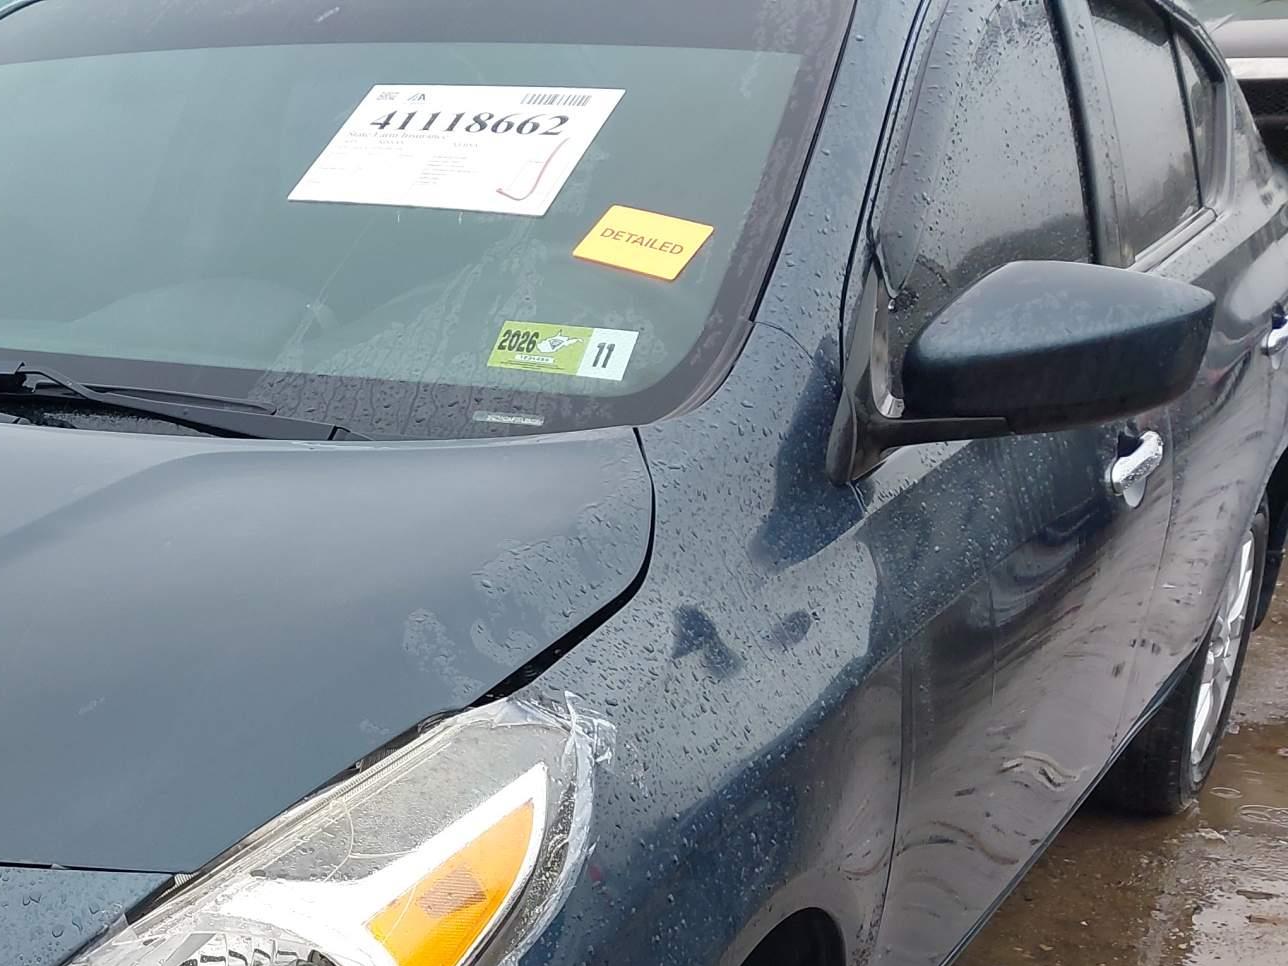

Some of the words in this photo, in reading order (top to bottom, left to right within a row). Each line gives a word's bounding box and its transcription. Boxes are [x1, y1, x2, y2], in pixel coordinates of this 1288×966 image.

[369, 110, 570, 136] 41118662
[599, 226, 685, 256] DETAILED
[497, 329, 540, 353] 2026
[592, 342, 616, 369] 11
